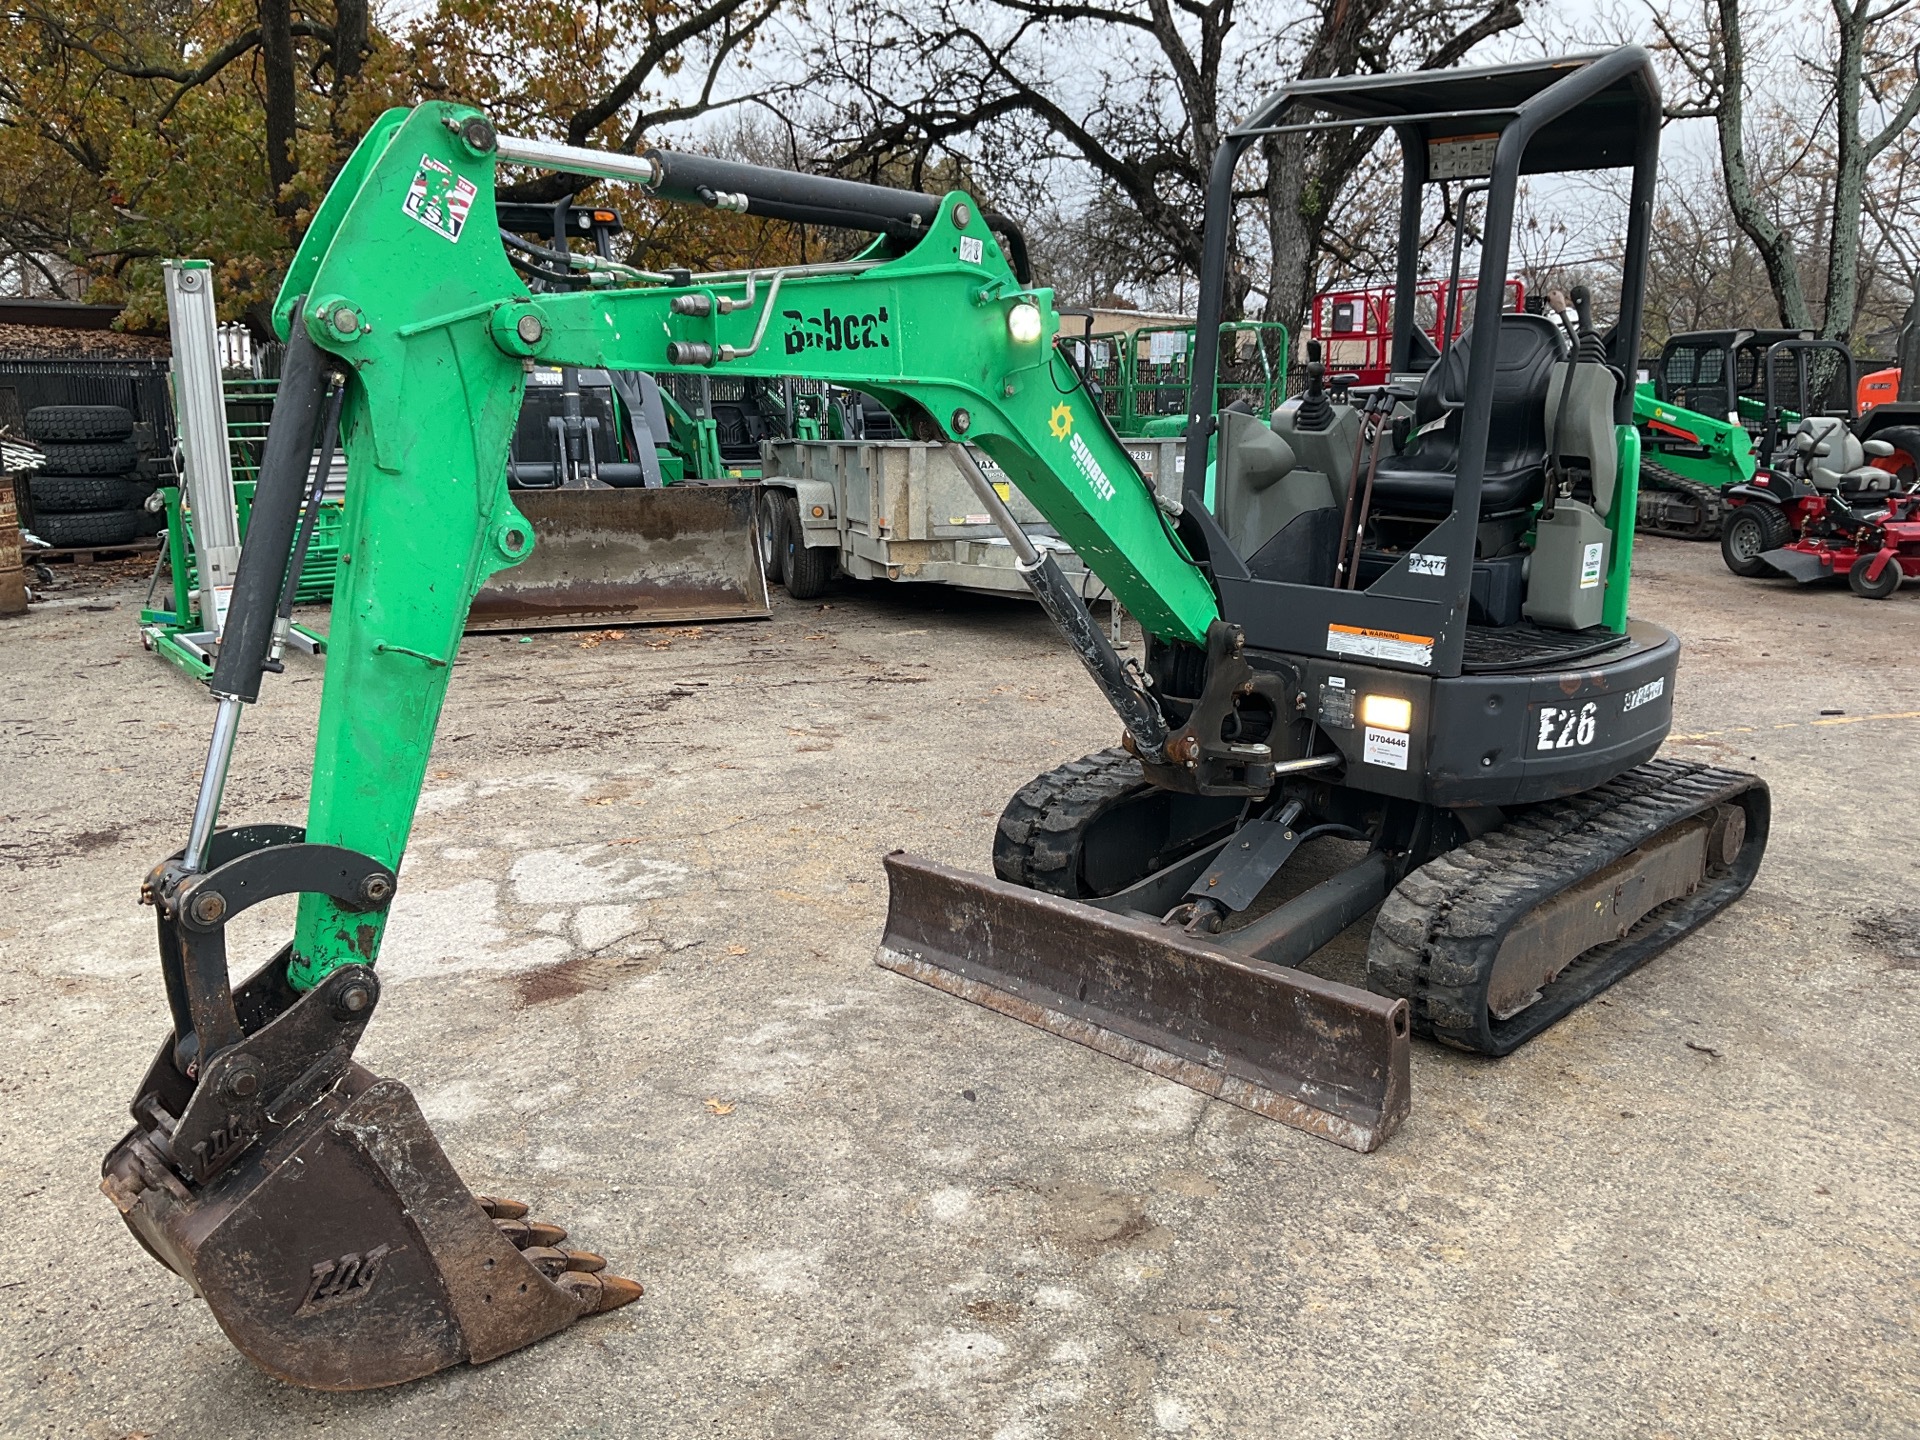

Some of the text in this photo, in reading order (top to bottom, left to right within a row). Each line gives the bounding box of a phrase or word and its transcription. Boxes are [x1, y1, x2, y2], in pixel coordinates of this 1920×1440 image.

[458, 181, 474, 193] THE
[1070, 432, 1116, 501] SUNBELT
[1071, 453, 1102, 499] RENTALS
[1409, 557, 1446, 570] 973477
[1368, 630, 1400, 640] WARNING
[1537, 702, 1597, 750] E26
[1368, 733, 1407, 748] U704446
